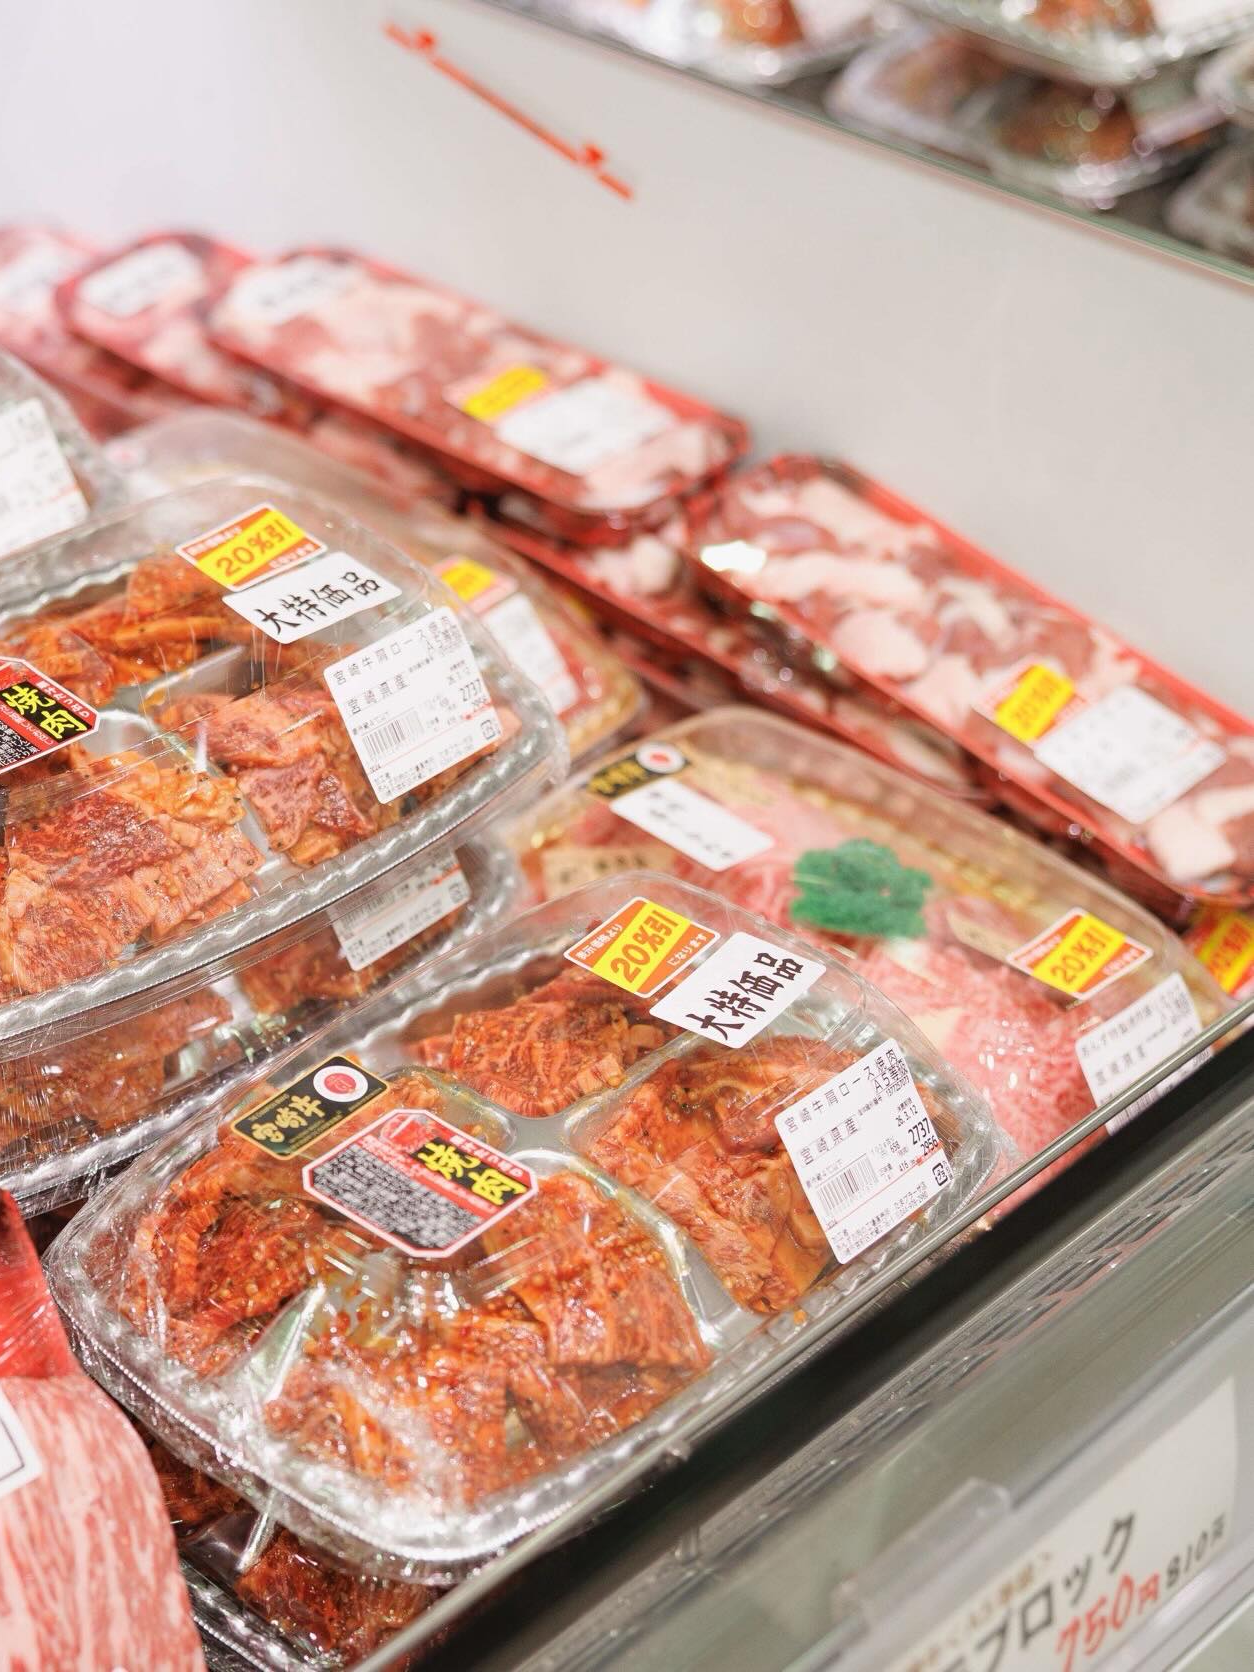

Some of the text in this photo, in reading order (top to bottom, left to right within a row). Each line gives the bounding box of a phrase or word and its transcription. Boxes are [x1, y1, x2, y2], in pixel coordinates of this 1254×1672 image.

[216, 518, 293, 578] 20%引
[253, 571, 381, 635] 大特価品
[4, 685, 88, 740] 焼肉
[610, 909, 680, 985] 20%引
[665, 932, 709, 969] になります
[684, 951, 805, 1041] 大特価品
[251, 1094, 327, 1144] 宮崎牛
[784, 1048, 897, 1134] 宮崎牛肩ロース焼肉
[800, 1118, 859, 1166] 宮崎県産
[908, 1117, 932, 1146] 2737
[920, 1135, 939, 1157] 2956
[417, 1140, 528, 1206] 焼肉
